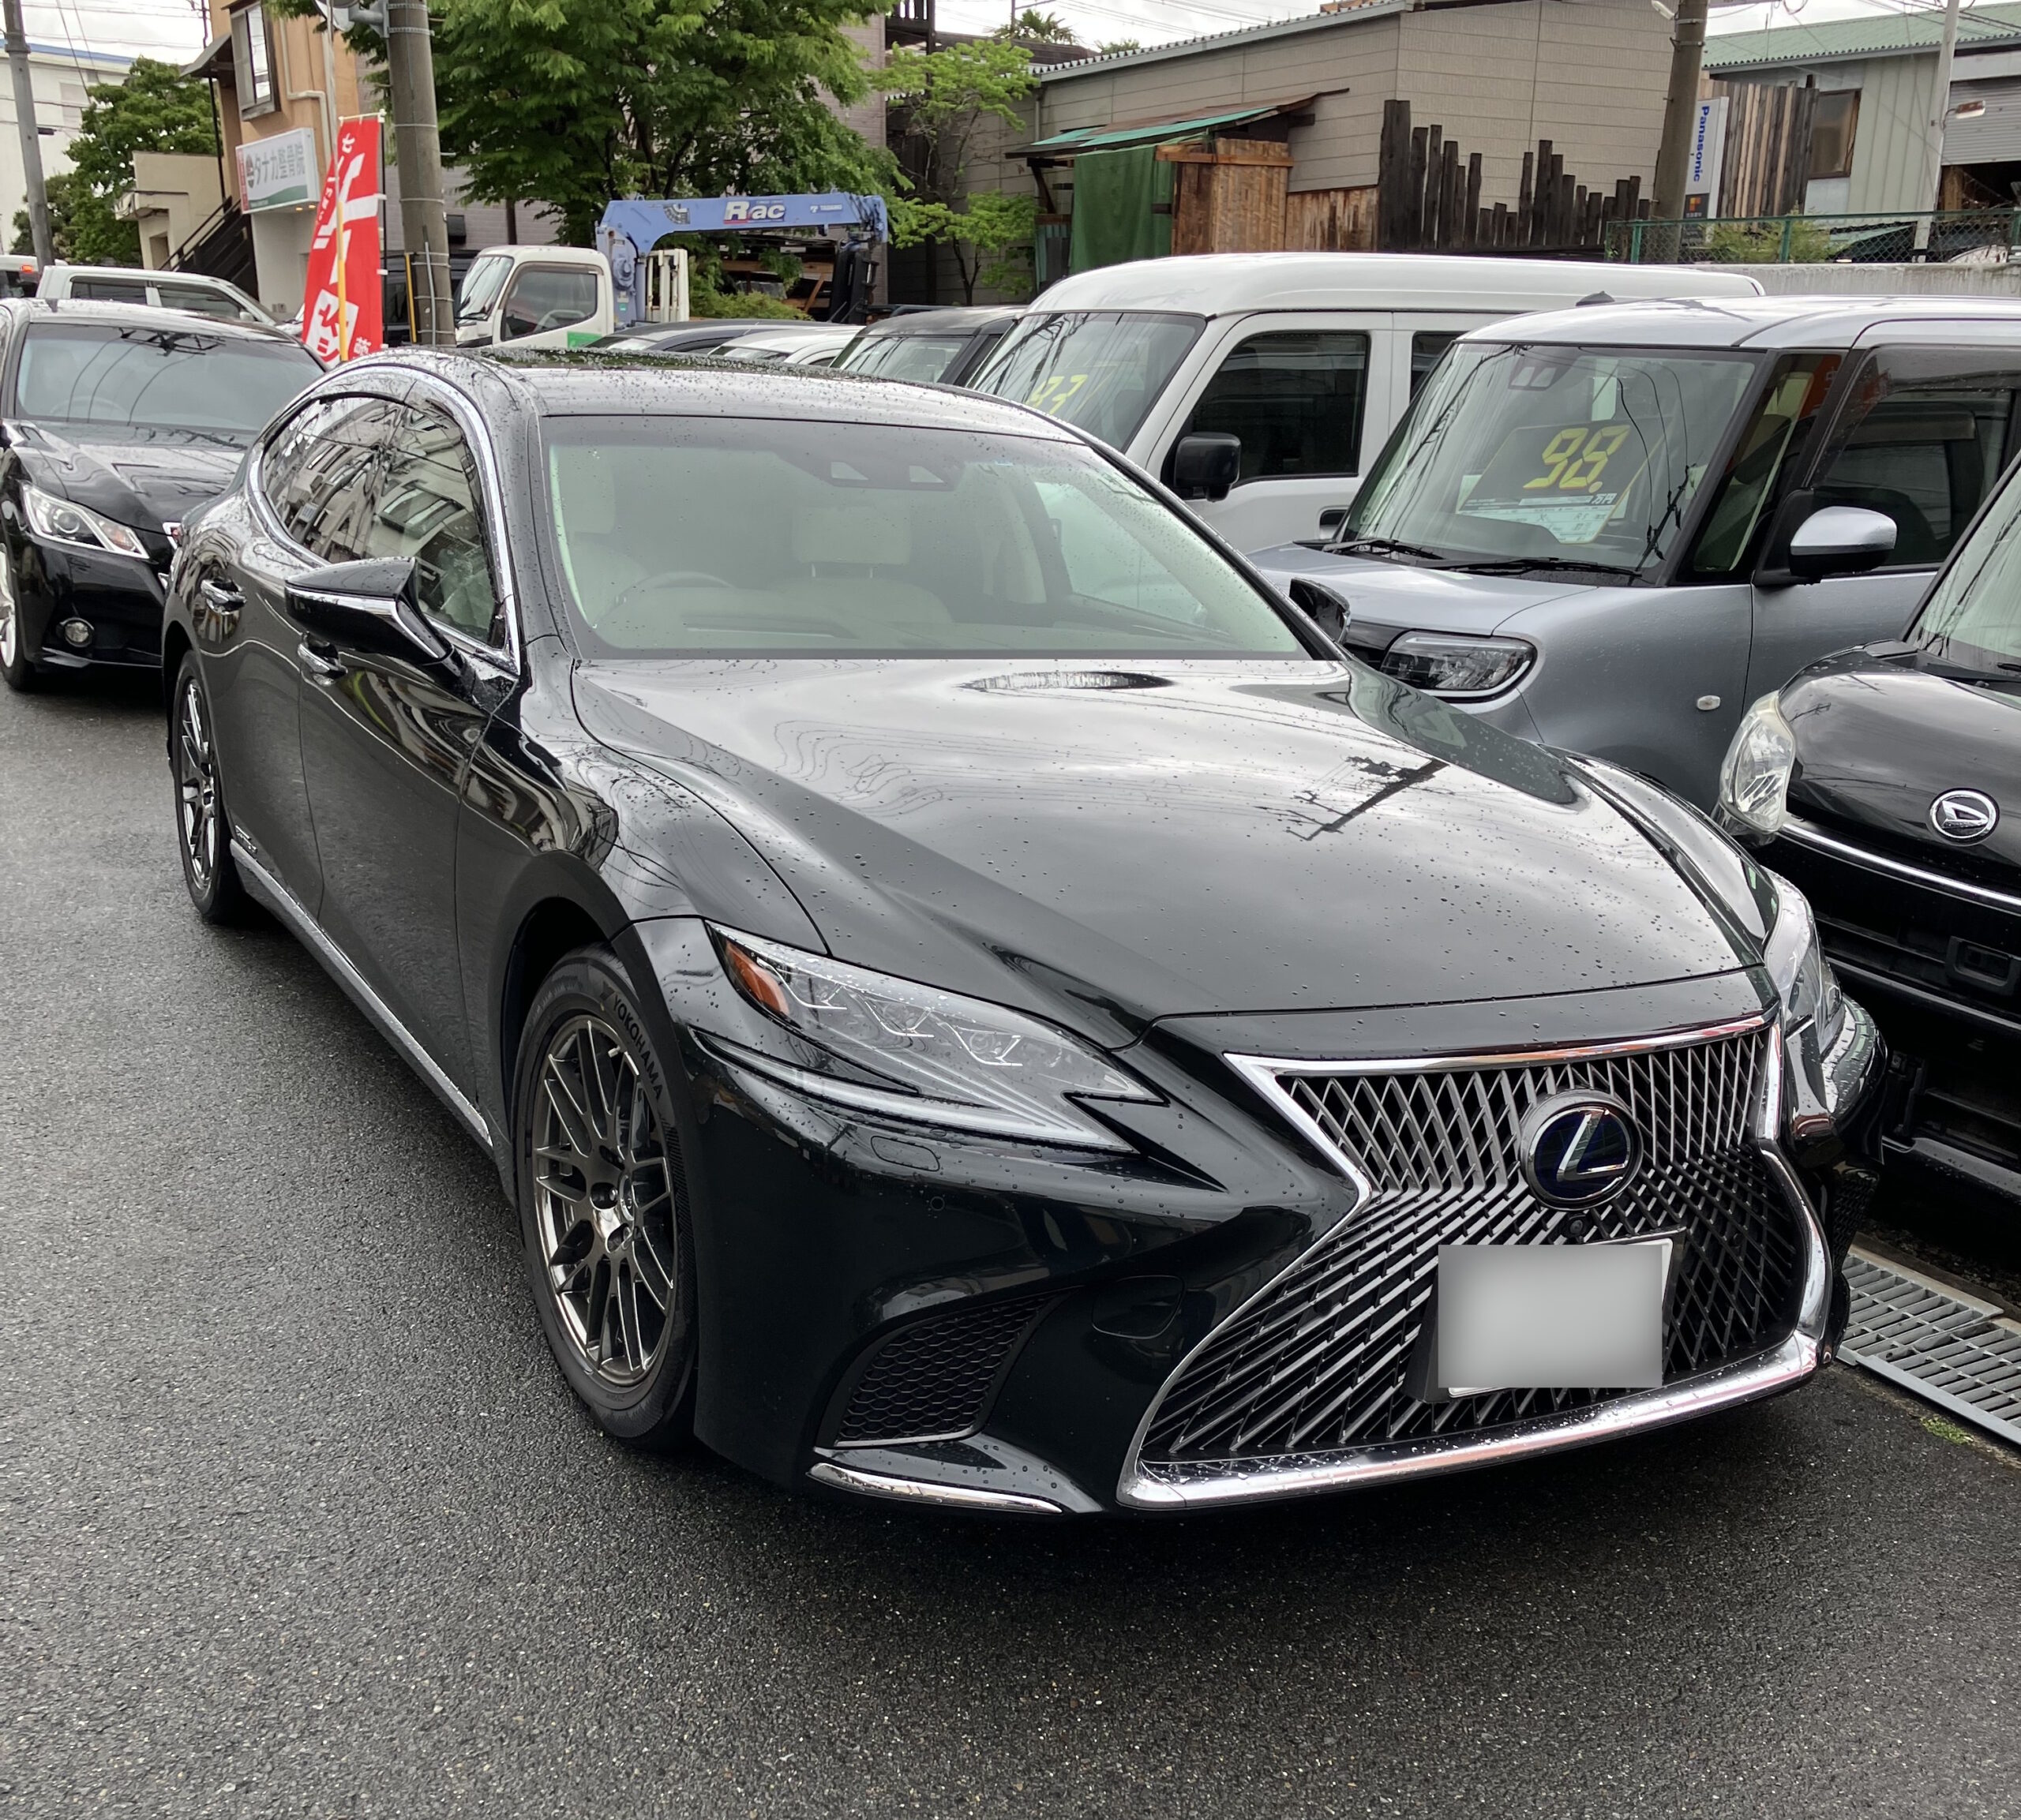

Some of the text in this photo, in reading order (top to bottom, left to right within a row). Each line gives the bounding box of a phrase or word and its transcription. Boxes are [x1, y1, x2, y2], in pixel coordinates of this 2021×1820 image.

[1693, 106, 1710, 182] Panasonic
[724, 200, 786, 221] Rac
[1591, 492, 1617, 504] 万円
[613, 995, 663, 1100] YOKOHAMA
